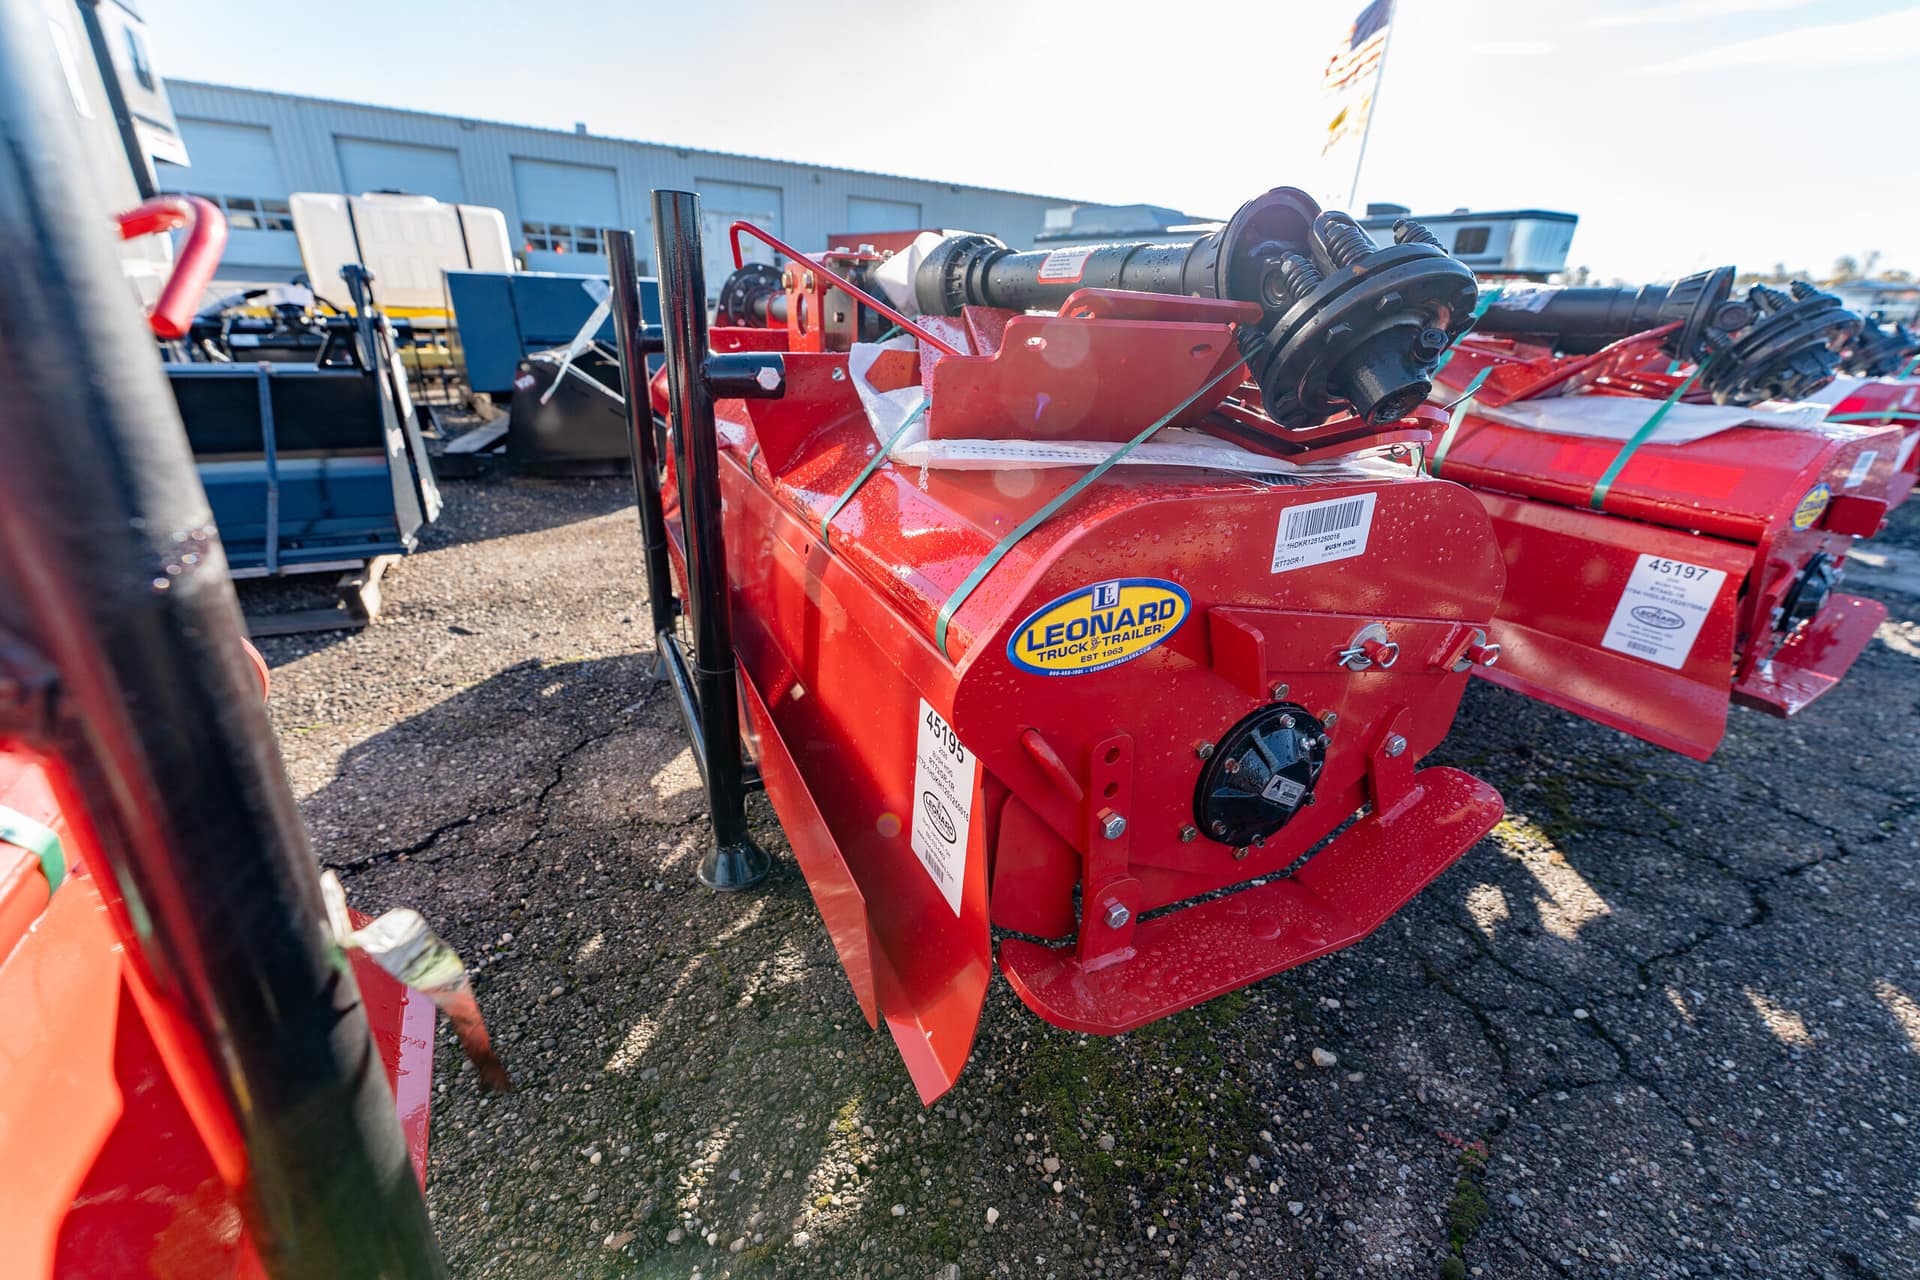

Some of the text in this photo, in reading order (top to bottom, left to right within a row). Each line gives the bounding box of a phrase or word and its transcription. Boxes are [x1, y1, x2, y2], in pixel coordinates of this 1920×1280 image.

[1648, 559, 1709, 581] 45197
[1027, 598, 1177, 652] LEONARD
[1036, 640, 1089, 663] TRUCK
[1102, 624, 1162, 647] TRAILER
[1080, 646, 1124, 664] EST 1963
[925, 710, 964, 764] 45195
[925, 794, 953, 836] LEONARD
